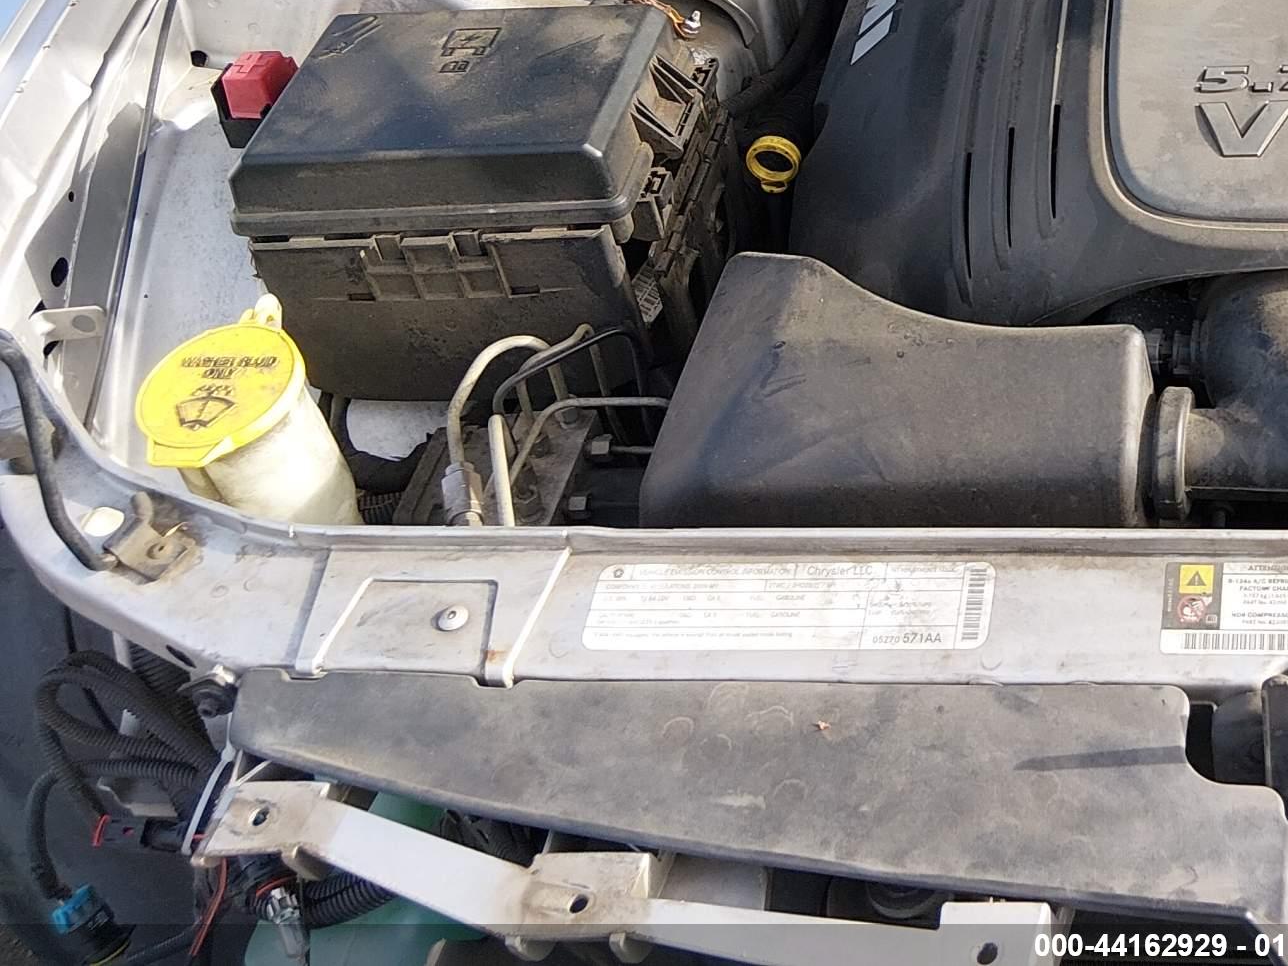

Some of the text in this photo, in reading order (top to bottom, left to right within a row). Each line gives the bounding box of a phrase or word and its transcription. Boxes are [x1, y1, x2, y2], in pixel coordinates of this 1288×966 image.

[181, 355, 280, 369] WASHER FLUID
[202, 368, 238, 380] ONLY
[807, 565, 851, 579] Chrysler
[853, 565, 873, 576] LLC
[903, 632, 942, 644] 571AA
